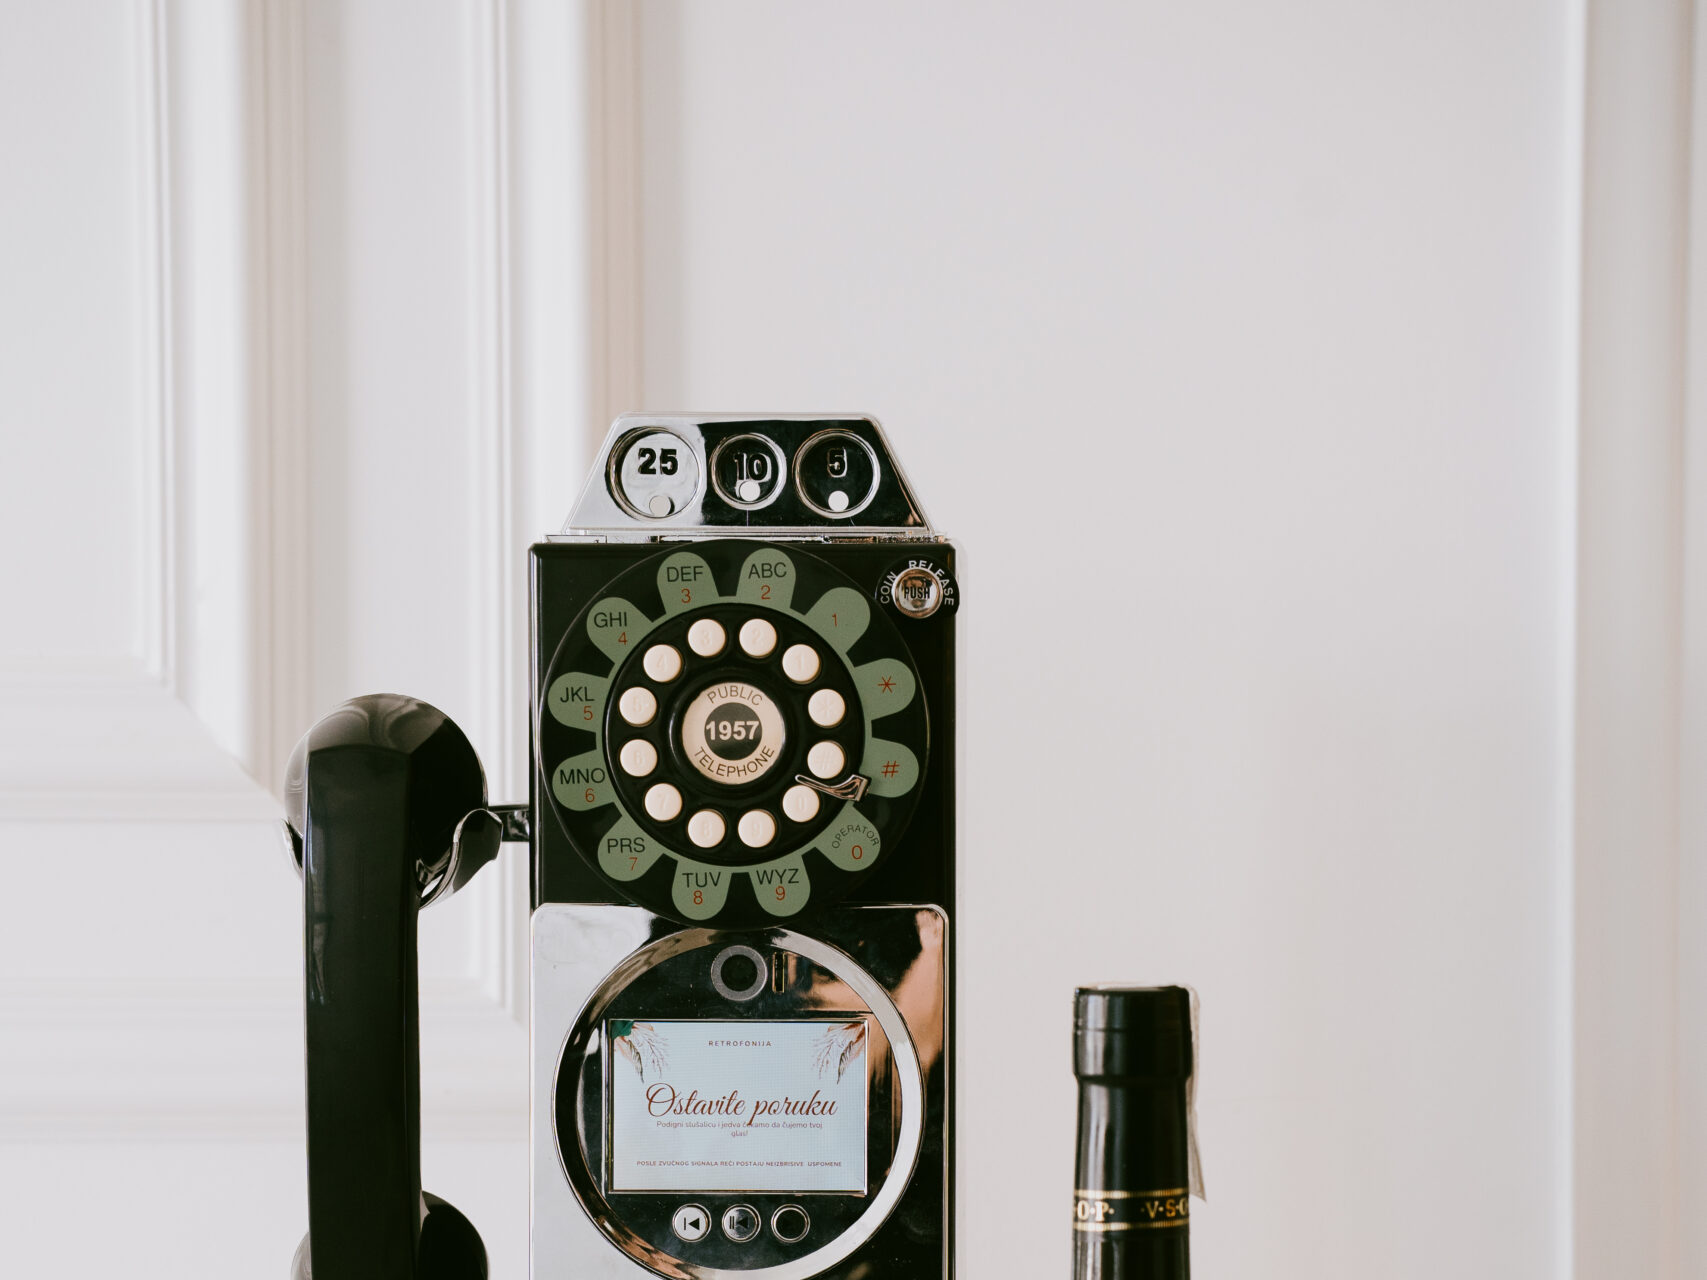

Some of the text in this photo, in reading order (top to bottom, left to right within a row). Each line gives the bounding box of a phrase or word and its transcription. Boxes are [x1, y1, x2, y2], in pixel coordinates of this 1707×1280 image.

[638, 448, 678, 475] 25
[735, 452, 769, 481] 10
[828, 447, 848, 477] 5
[666, 565, 704, 583] DEF
[748, 562, 787, 579] ABC
[880, 560, 955, 606] COIN RELEASE
[681, 588, 691, 603] 3
[760, 585, 771, 600] 2
[904, 586, 930, 599] PUSH
[593, 612, 628, 628] GHI
[831, 613, 839, 627] 1
[618, 632, 628, 646] 4
[560, 687, 595, 703] JKL
[707, 685, 763, 706] PUBLIC
[583, 705, 593, 721] 5
[706, 721, 759, 741] 1957
[694, 746, 774, 777] TELEPHONE
[881, 761, 899, 778] #
[560, 768, 605, 785] MNO
[585, 788, 595, 803] 6
[831, 824, 880, 850] OPERATOR
[607, 838, 645, 855] PRS
[851, 845, 863, 861] 0
[628, 857, 638, 871] 7
[682, 872, 721, 888] TUV
[755, 869, 800, 885] WYZ
[693, 890, 703, 906] 8
[775, 886, 786, 902] 9
[646, 1082, 838, 1127] Ostavite poruku
[656, 1120, 684, 1129] Podigni
